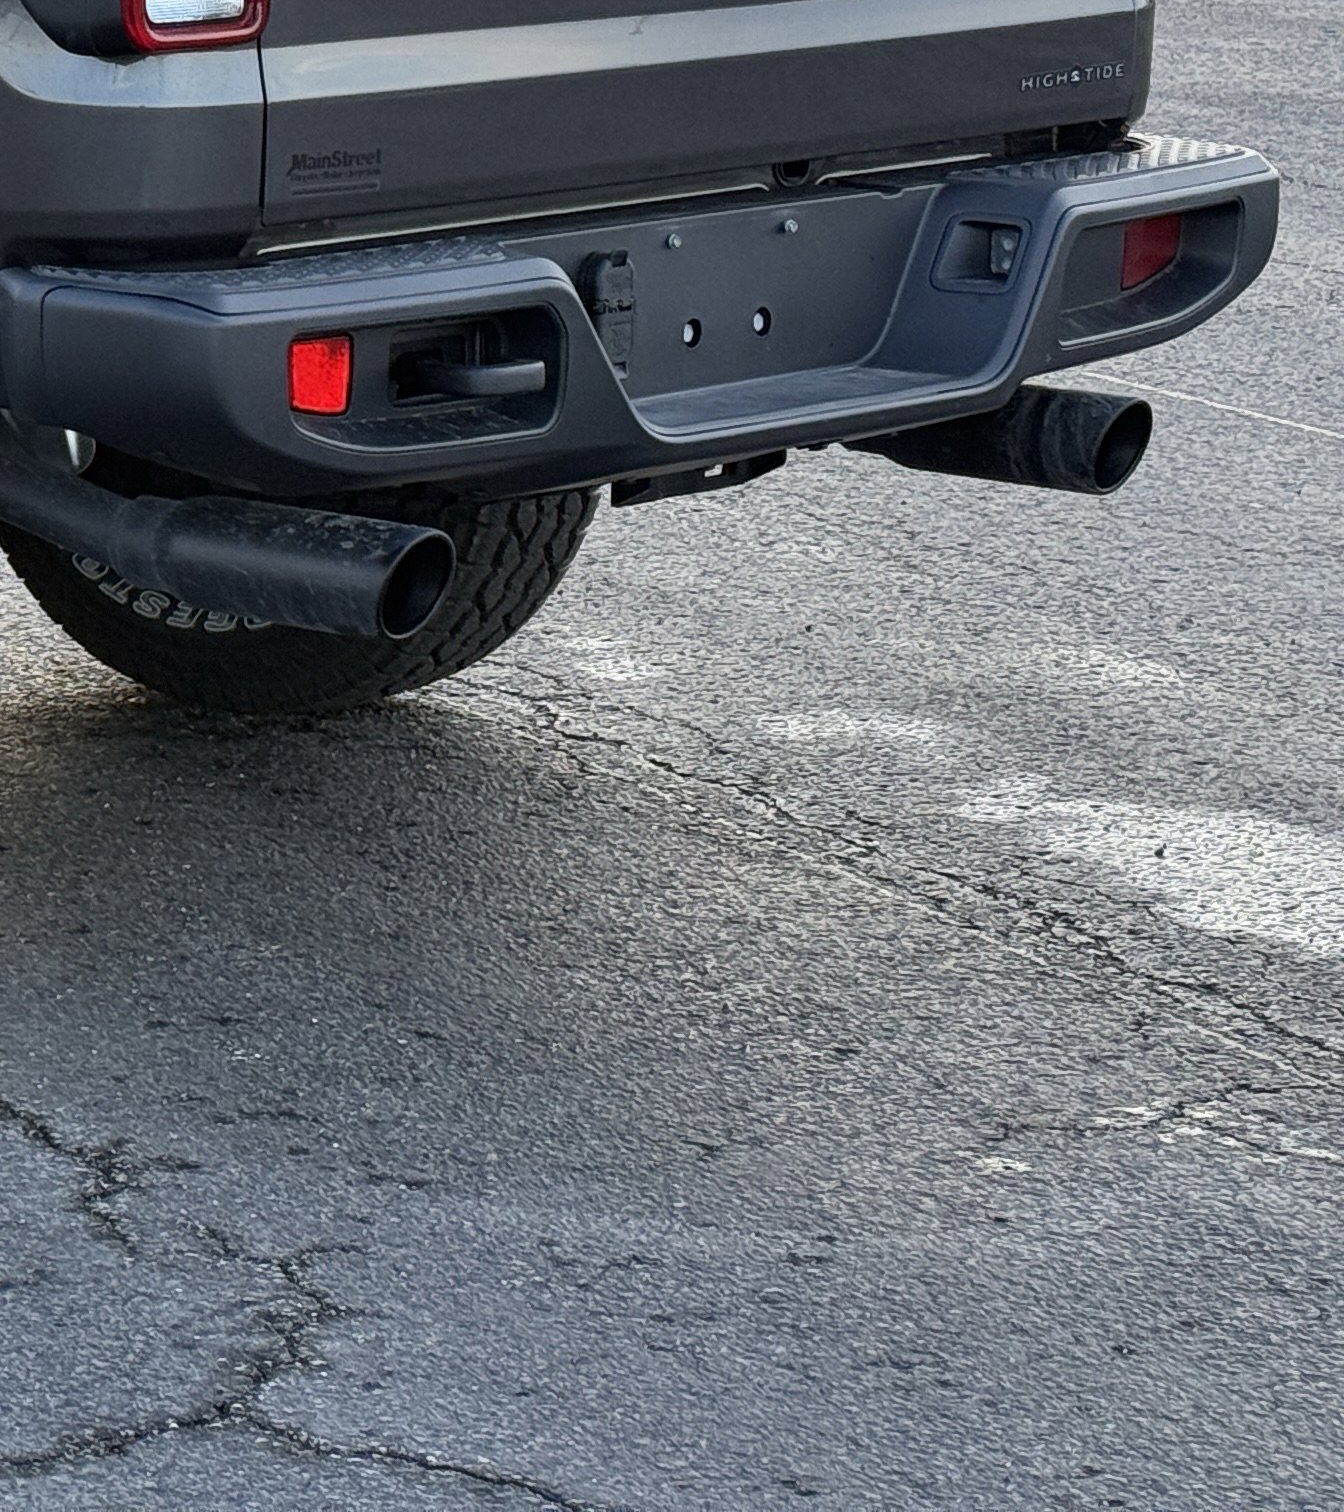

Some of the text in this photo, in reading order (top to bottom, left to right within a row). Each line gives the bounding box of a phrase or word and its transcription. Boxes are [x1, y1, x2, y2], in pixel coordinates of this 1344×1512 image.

[1020, 63, 1125, 92] HIGH TIDE
[287, 148, 383, 177] MainStreet
